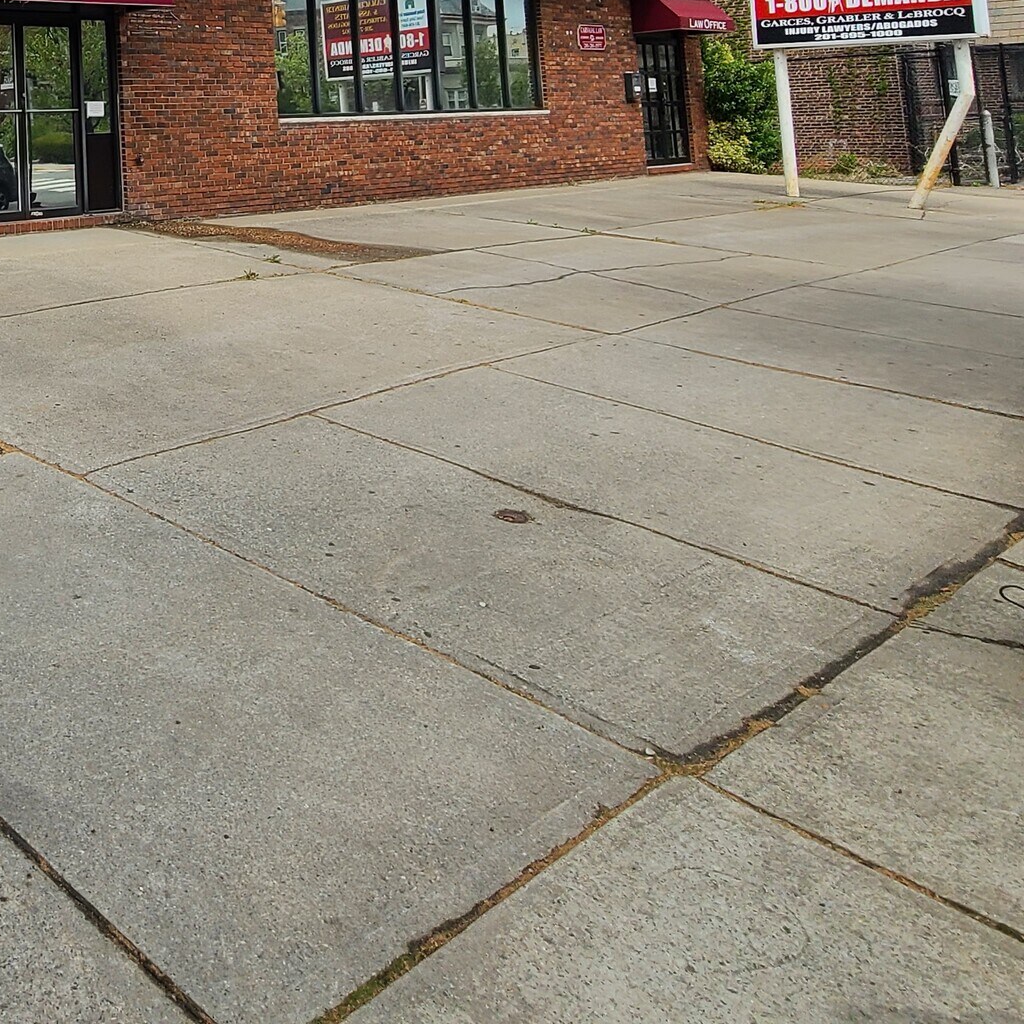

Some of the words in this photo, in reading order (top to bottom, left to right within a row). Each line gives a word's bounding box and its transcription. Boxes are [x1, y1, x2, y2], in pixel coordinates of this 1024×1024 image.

[689, 18, 703, 29] LAW
[704, 19, 727, 30] OFFICE
[760, 17, 815, 28] GARCES,
[816, 12, 881, 25] GRABLER
[883, 11, 895, 20] &
[897, 7, 966, 19] LeBROCQ
[784, 25, 820, 35] INJURY
[821, 19, 938, 34] LAWYERS/ABOGADOS
[814, 29, 903, 41] 201-695-1000
